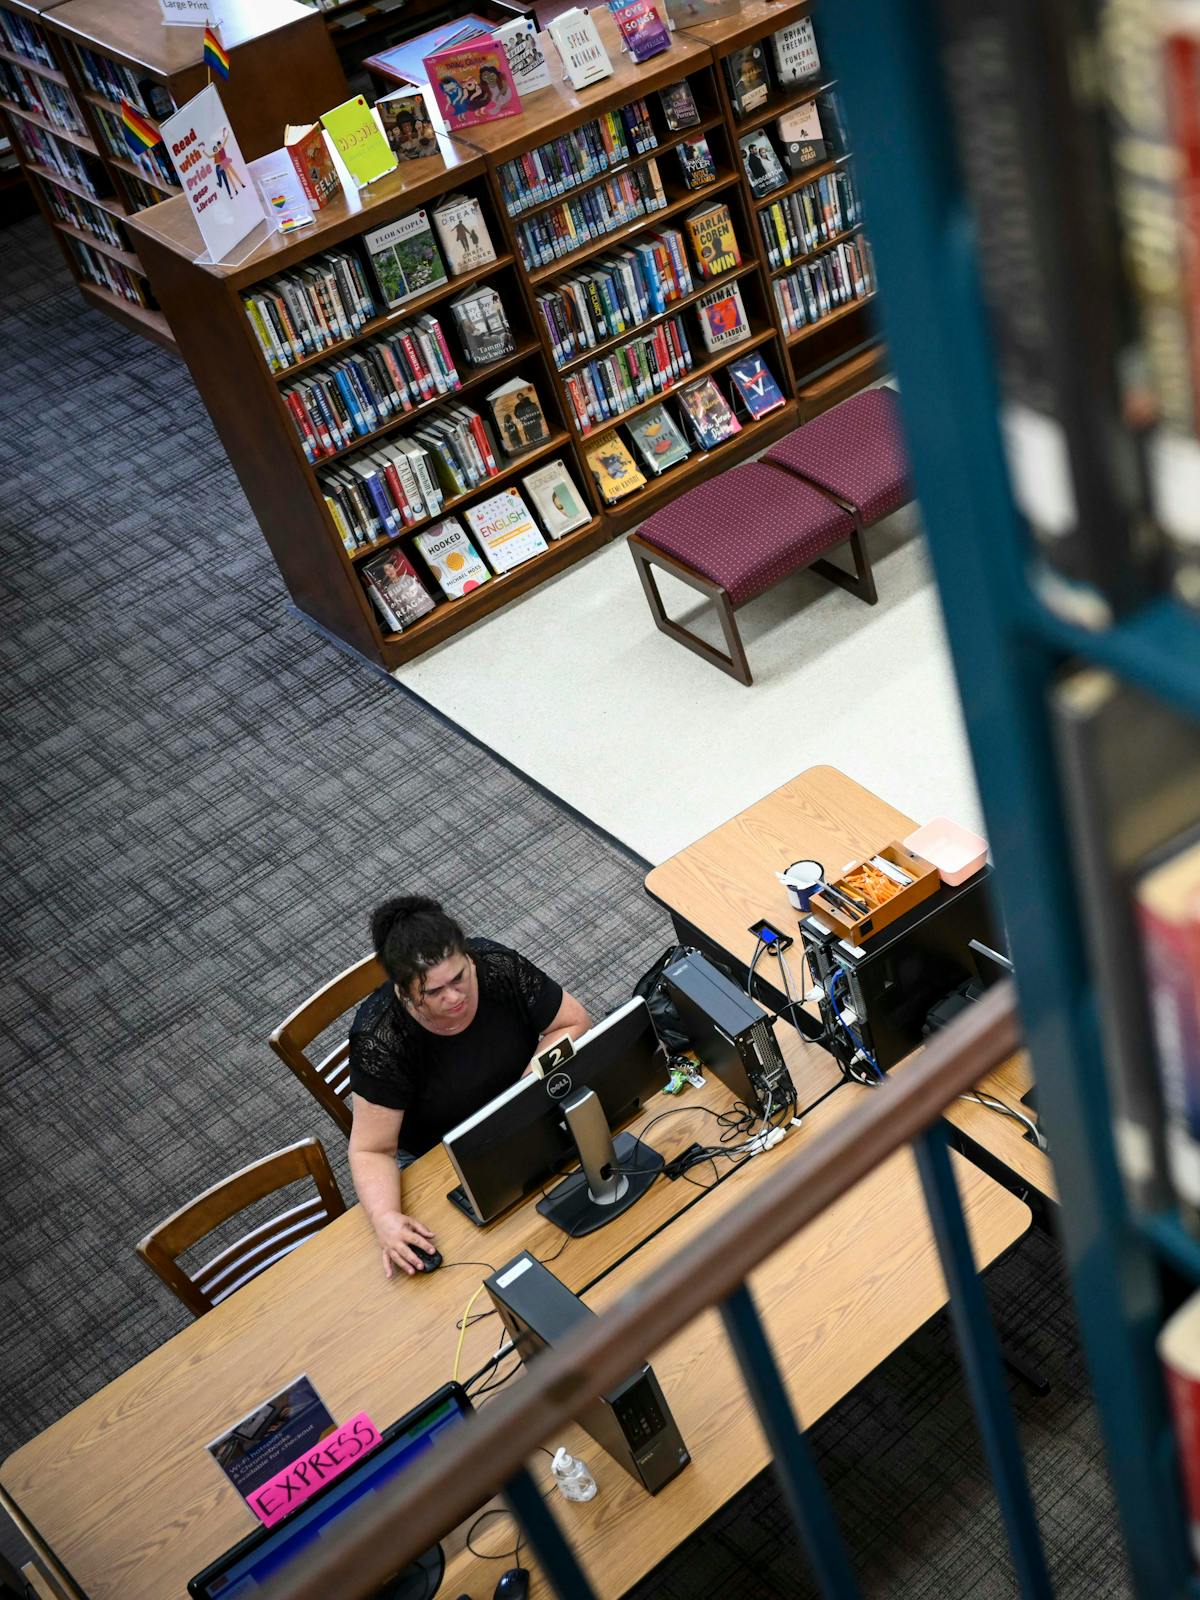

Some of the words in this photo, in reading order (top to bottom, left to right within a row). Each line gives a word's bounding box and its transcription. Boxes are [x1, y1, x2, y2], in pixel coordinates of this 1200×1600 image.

[620, 3, 644, 19] LOVE
[625, 10, 655, 32] SONGS
[782, 35, 813, 52] FREEMAN
[783, 25, 807, 42] BRIAN
[785, 49, 814, 65] FUNERAL
[172, 128, 197, 157] Read
[179, 149, 202, 173] with
[441, 206, 479, 226] DREAM
[692, 210, 731, 236] HARLAN
[375, 218, 424, 245] FLORATOPIA
[700, 223, 730, 246] COBEN
[708, 253, 737, 276] WIN
[701, 286, 738, 308] ANIMAL
[473, 345, 515, 363] Duckworth
[479, 341, 505, 354] Tammy
[735, 361, 764, 396] V
[398, 461, 420, 498] CALHOUN
[480, 508, 527, 538] ENGLISH
[427, 532, 461, 556] HOOKED
[446, 572, 468, 588] MICHAEL
[467, 564, 482, 577] MOSS
[549, 1048, 565, 1068] 2
[550, 1079, 569, 1095] DELL
[239, 1434, 291, 1473] Chromebooks
[268, 1449, 282, 1460] for
[279, 1424, 315, 1451] checkout
[255, 1420, 375, 1517] EXPRESS
